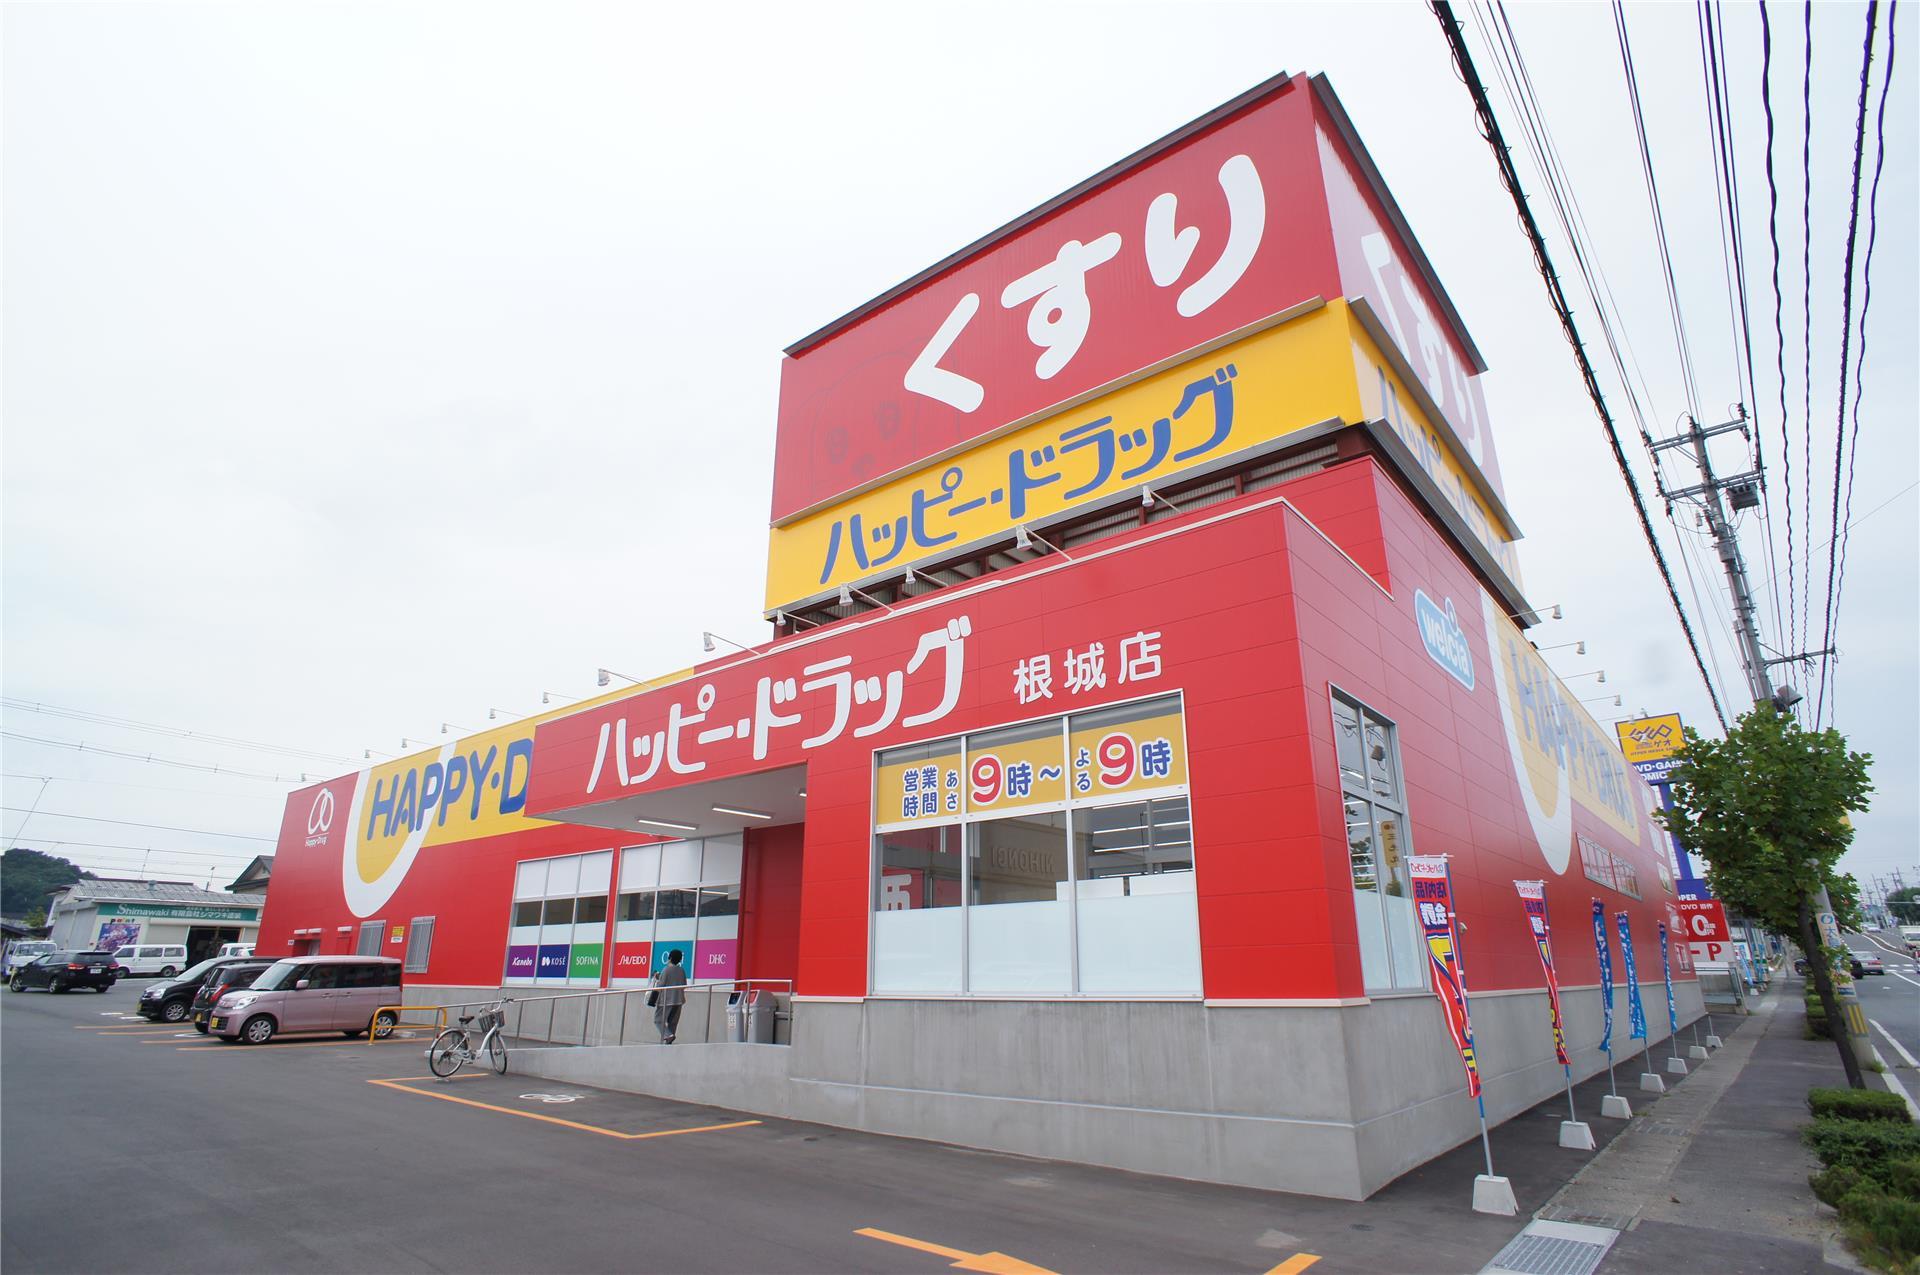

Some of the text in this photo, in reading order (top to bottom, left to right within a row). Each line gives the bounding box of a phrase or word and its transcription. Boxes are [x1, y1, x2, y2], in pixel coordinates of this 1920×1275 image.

[903, 154, 1266, 414] くすり
[1012, 630, 1163, 705] 根城店
[903, 766, 937, 793] 営業
[903, 792, 937, 817] 時間
[116, 903, 169, 917] Shimawaki
[511, 957, 534, 966] Kanebo
[575, 955, 599, 966] SOFINA
[617, 954, 647, 965] SHISEIDO
[708, 954, 726, 965] DHC
